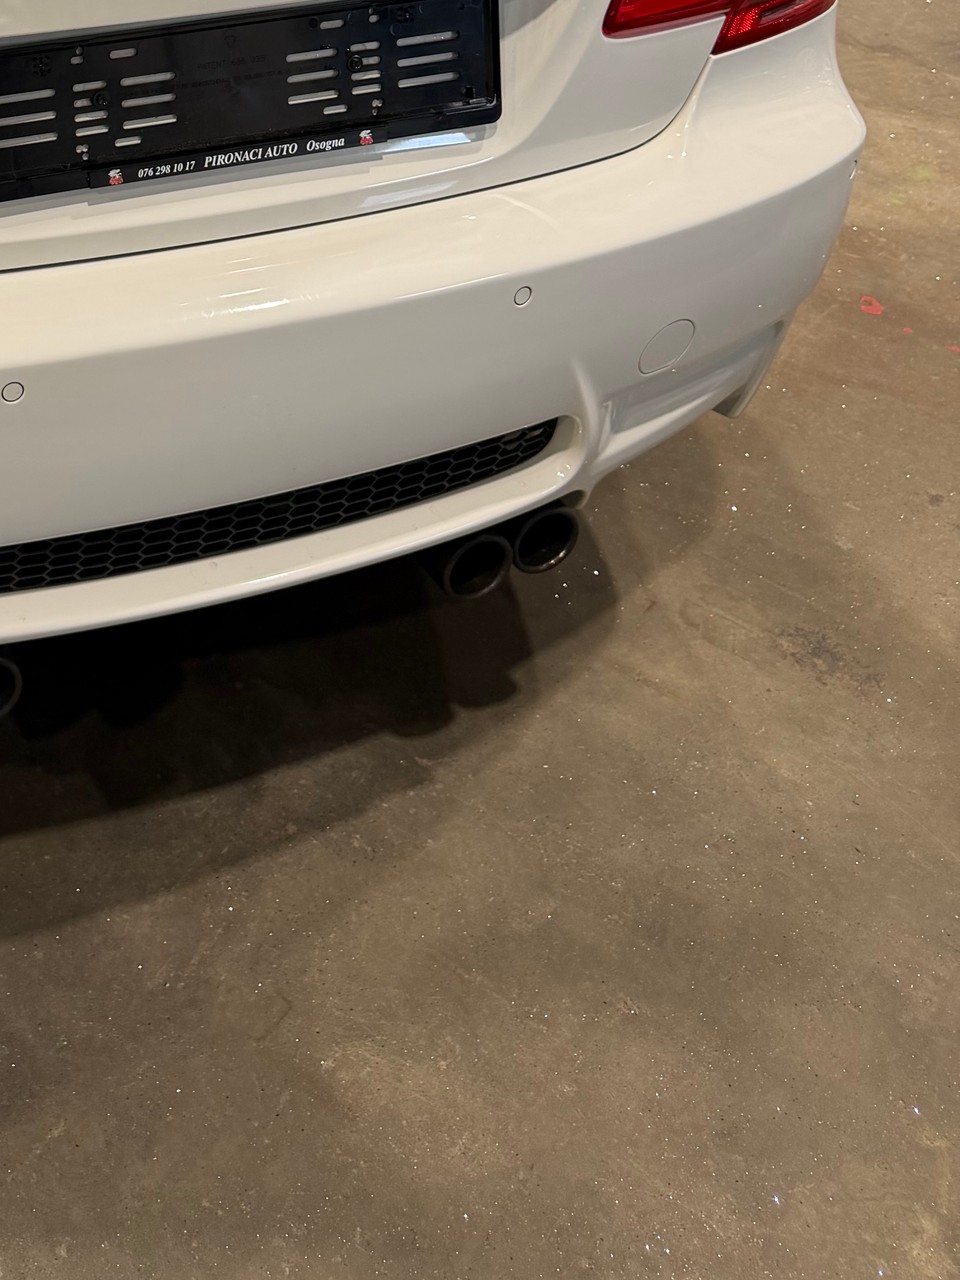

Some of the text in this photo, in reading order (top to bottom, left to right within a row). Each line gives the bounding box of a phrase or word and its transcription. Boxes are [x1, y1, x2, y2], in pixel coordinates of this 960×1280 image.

[137, 137, 345, 179] 076 298 10 17 PIRONACI AUTO Osogna
